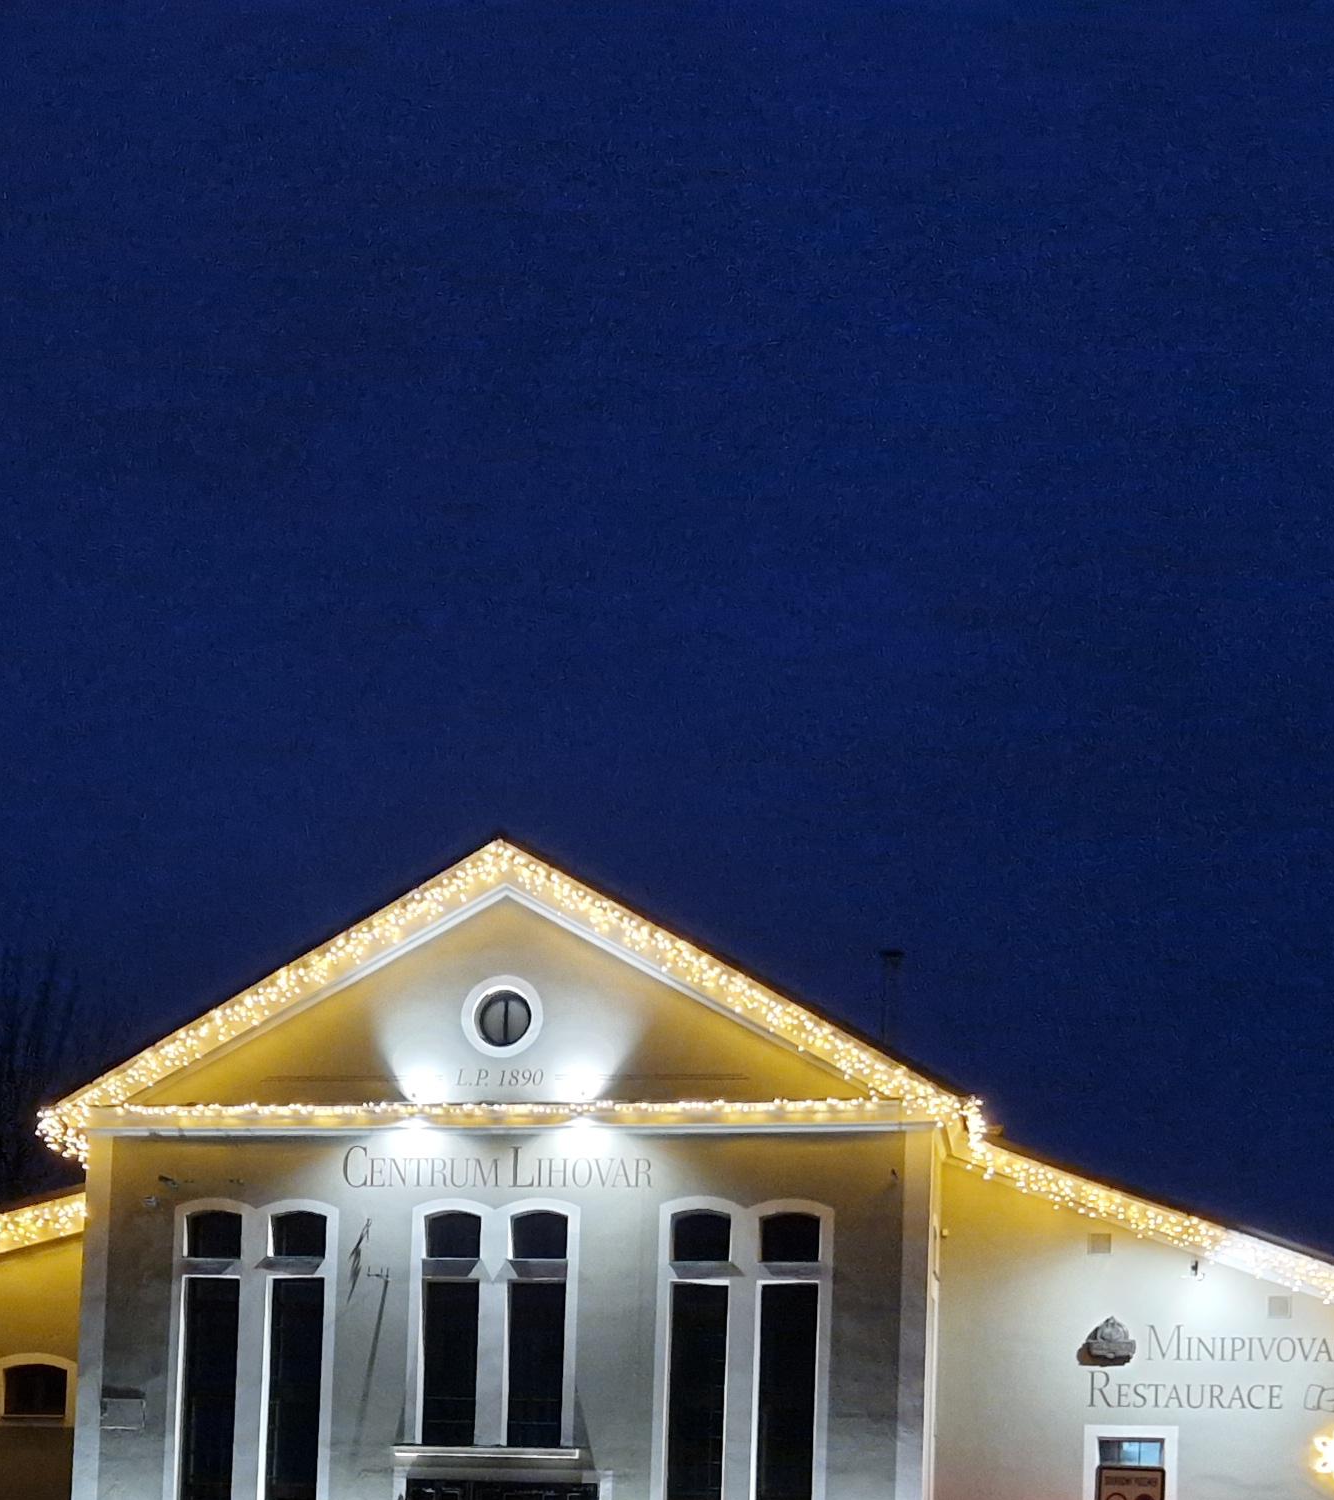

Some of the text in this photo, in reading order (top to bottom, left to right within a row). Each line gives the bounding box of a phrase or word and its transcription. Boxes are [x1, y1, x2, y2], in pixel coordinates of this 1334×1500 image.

[456, 1068, 544, 1087] L.P. 1890
[342, 1145, 653, 1189] CENTRUM LIHOVAR
[1086, 1370, 1284, 1410] RESTAURACE
